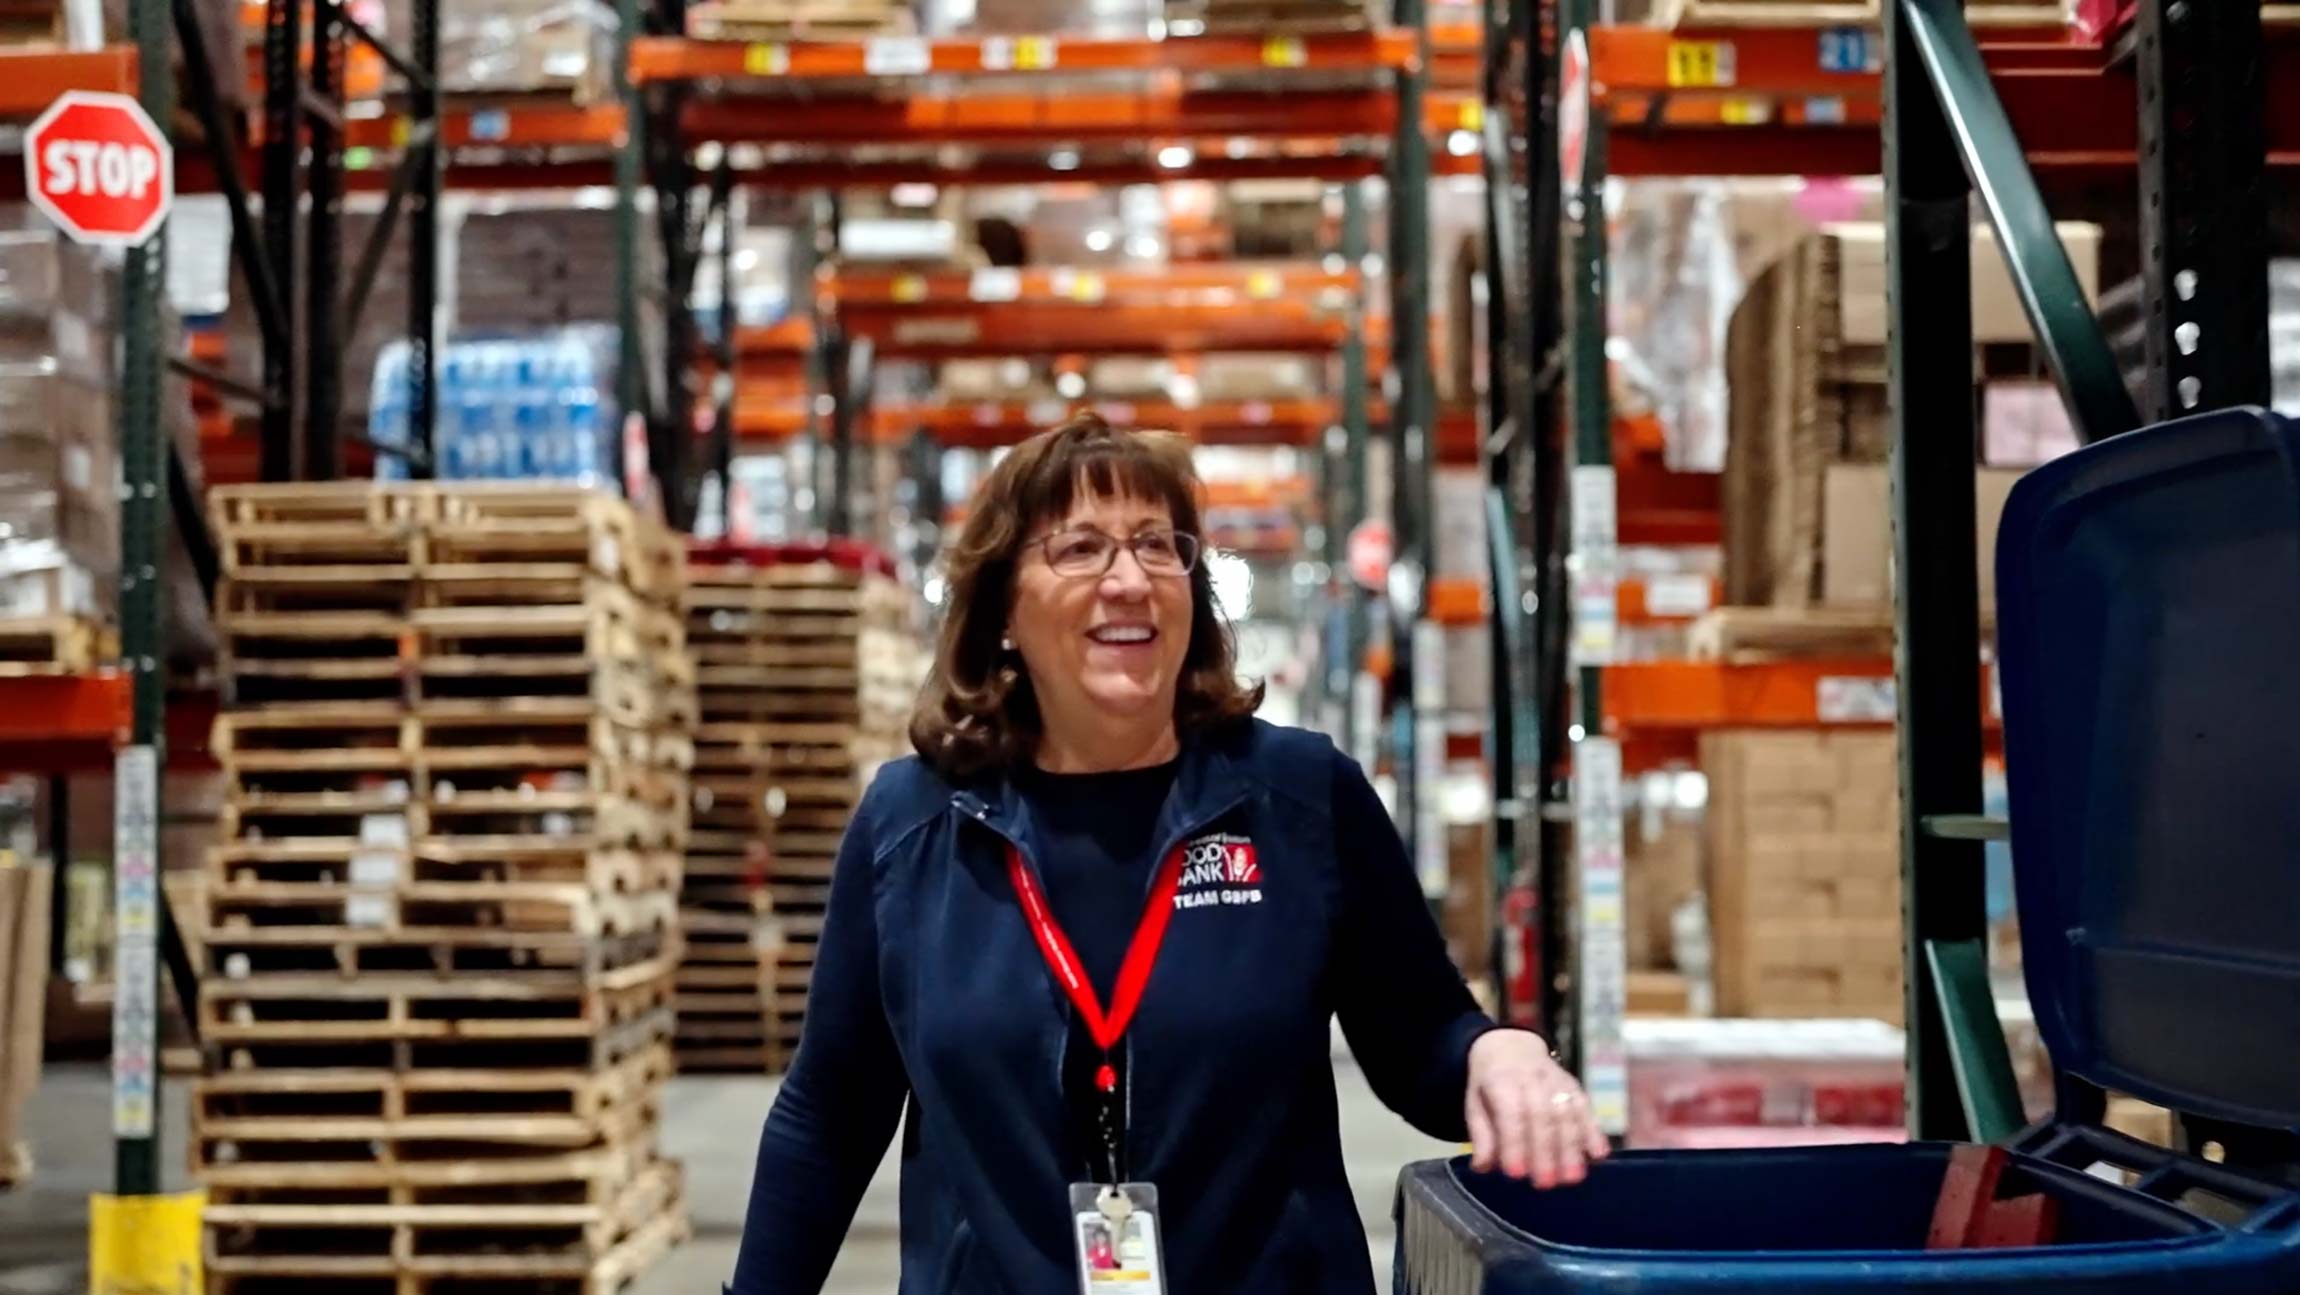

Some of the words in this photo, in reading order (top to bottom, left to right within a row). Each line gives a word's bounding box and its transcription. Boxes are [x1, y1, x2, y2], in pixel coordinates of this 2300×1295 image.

[44, 139, 157, 199] STOP
[1181, 842, 1222, 868] OOD
[1177, 861, 1224, 888] ANK
[1173, 890, 1219, 909] TEAM
